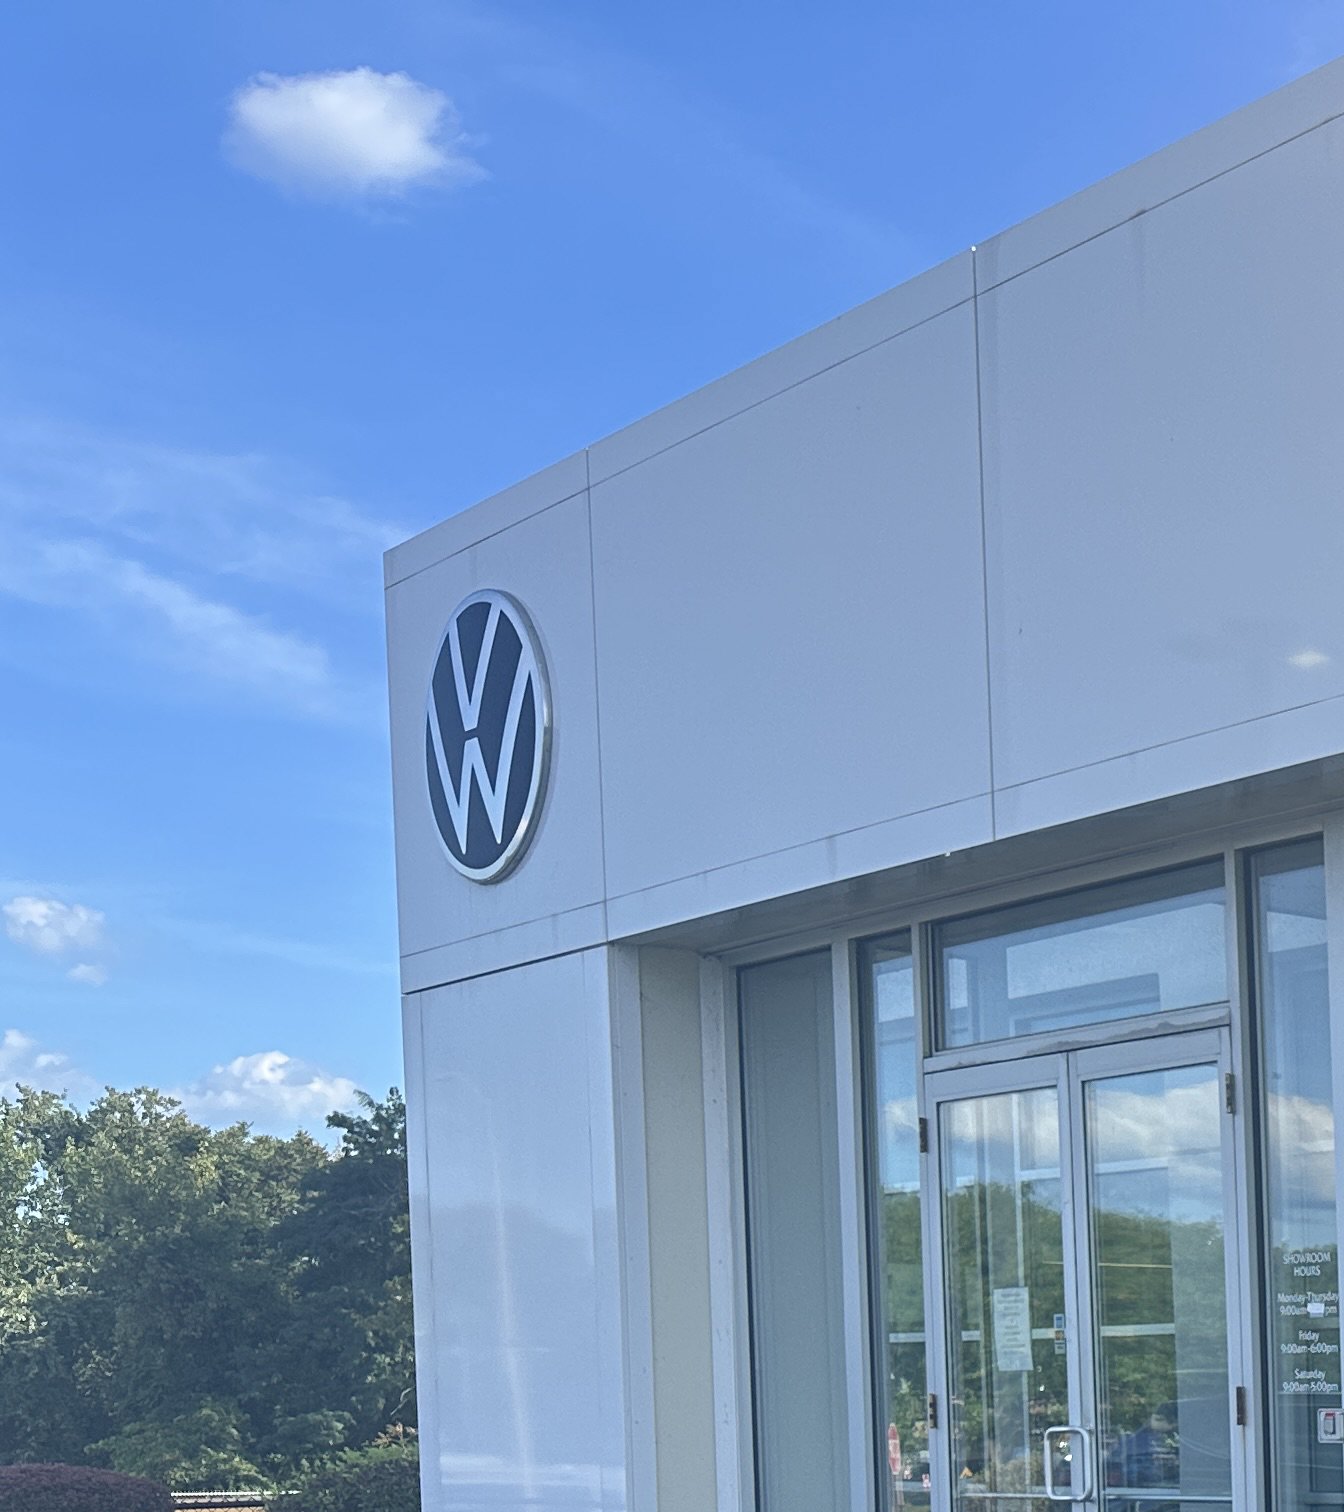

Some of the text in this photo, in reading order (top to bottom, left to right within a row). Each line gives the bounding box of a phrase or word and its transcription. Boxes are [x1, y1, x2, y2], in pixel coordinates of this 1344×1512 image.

[424, 587, 554, 884] VW
[1282, 1252, 1331, 1264] SHOWROOM
[1293, 1265, 1321, 1276] HOURS
[1277, 1291, 1339, 1305] Monday-Thursday
[1298, 1329, 1320, 1342] Friday
[1294, 1368, 1326, 1381] Saturday
